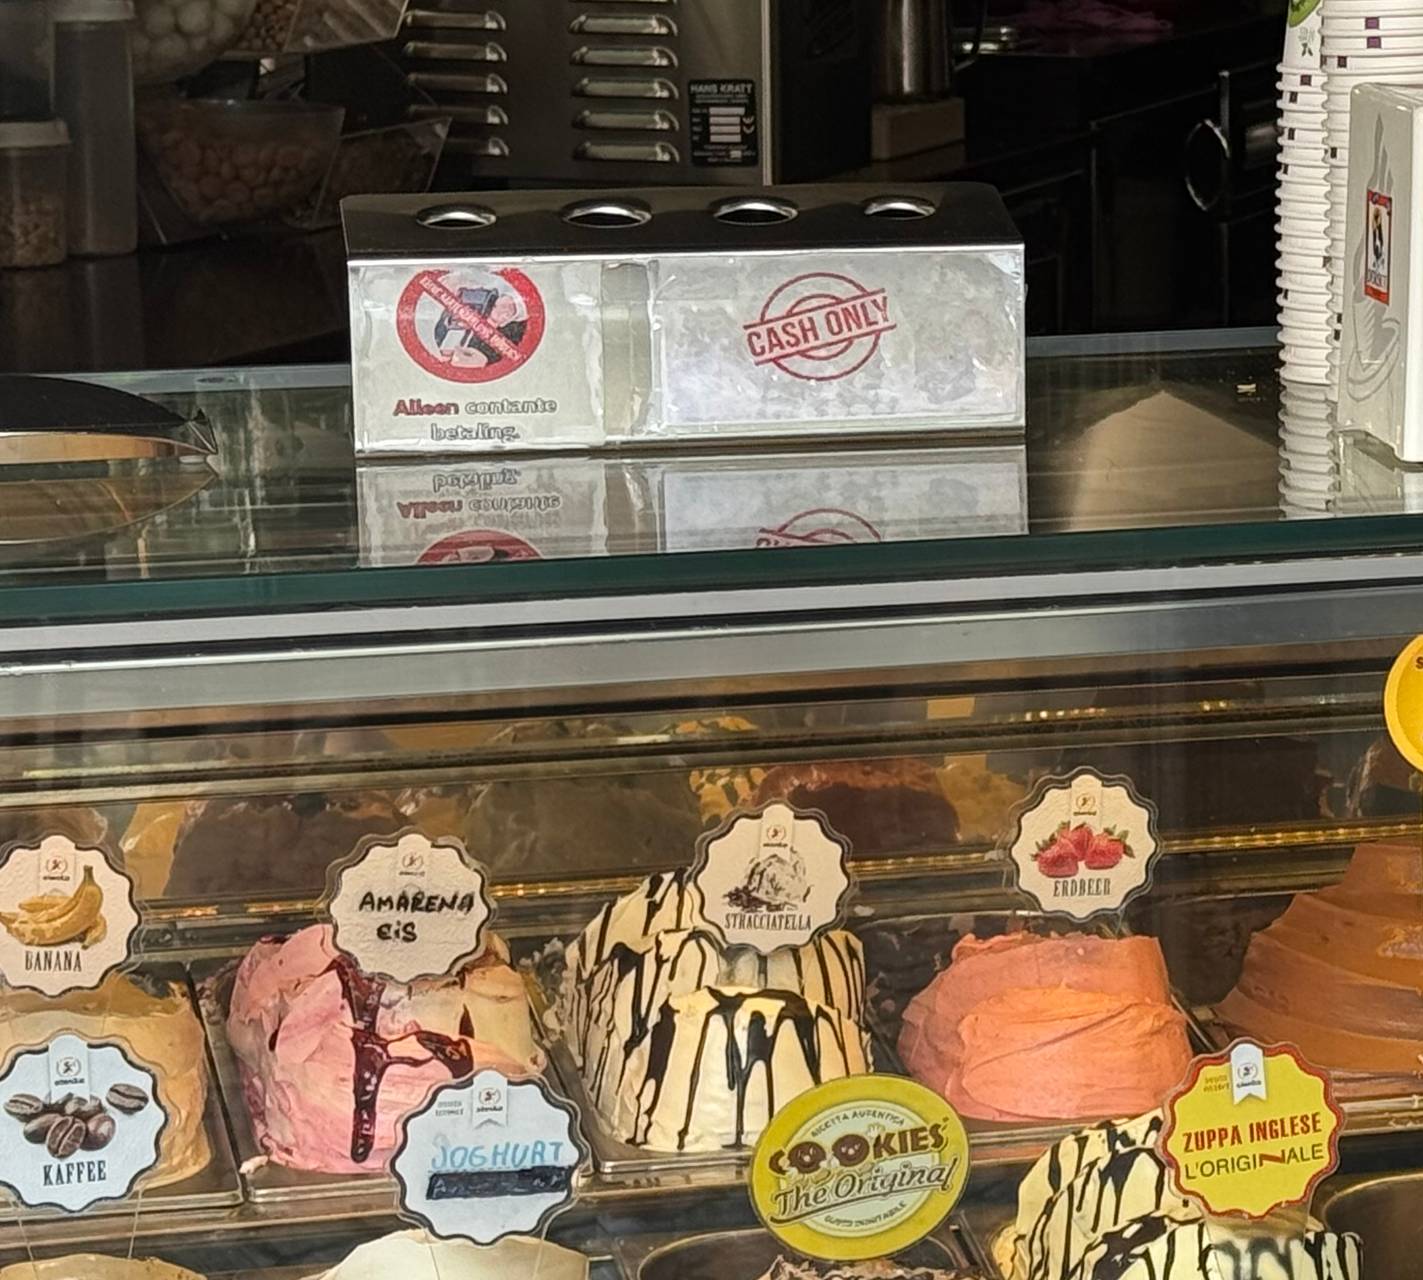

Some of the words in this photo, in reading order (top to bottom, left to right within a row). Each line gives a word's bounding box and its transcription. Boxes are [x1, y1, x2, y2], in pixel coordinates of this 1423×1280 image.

[747, 316, 820, 357] CASH
[824, 295, 890, 337] ONLY
[393, 398, 459, 416] Alleen
[465, 398, 558, 415] contante
[1053, 878, 1112, 898] ERDBEER
[359, 891, 475, 915] AMARENA
[724, 912, 812, 931] STRACCIATELLA
[25, 950, 82, 973] BANANA
[1183, 1124, 1243, 1154] ZUPPA
[1249, 1111, 1323, 1144] INGLESE
[431, 1140, 564, 1170] JOGHURT
[1185, 1143, 1325, 1181] L'ORIGINALE
[43, 1160, 107, 1187] KAFFEE
[774, 1184, 828, 1217] The
[835, 1156, 958, 1200] Original
